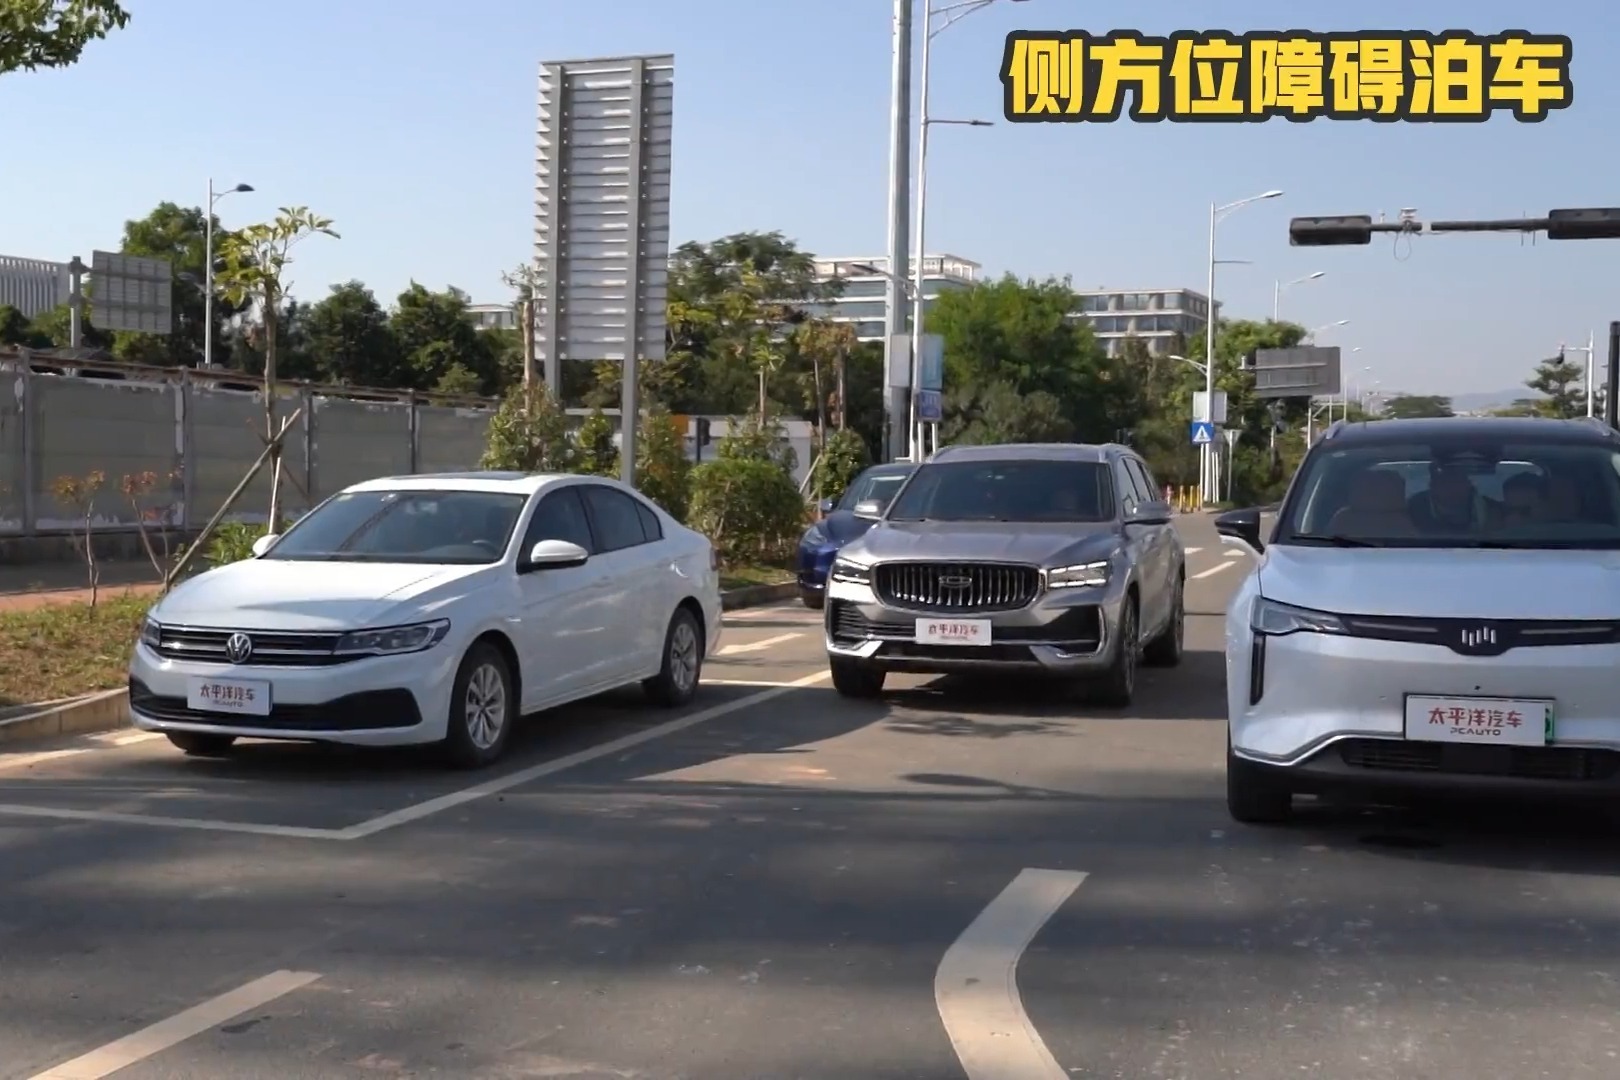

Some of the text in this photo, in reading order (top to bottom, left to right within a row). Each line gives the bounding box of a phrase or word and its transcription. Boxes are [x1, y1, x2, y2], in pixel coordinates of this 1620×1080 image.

[200, 683, 256, 702] 太平洋汽车
[1428, 707, 1523, 729] 太平洋汽车
